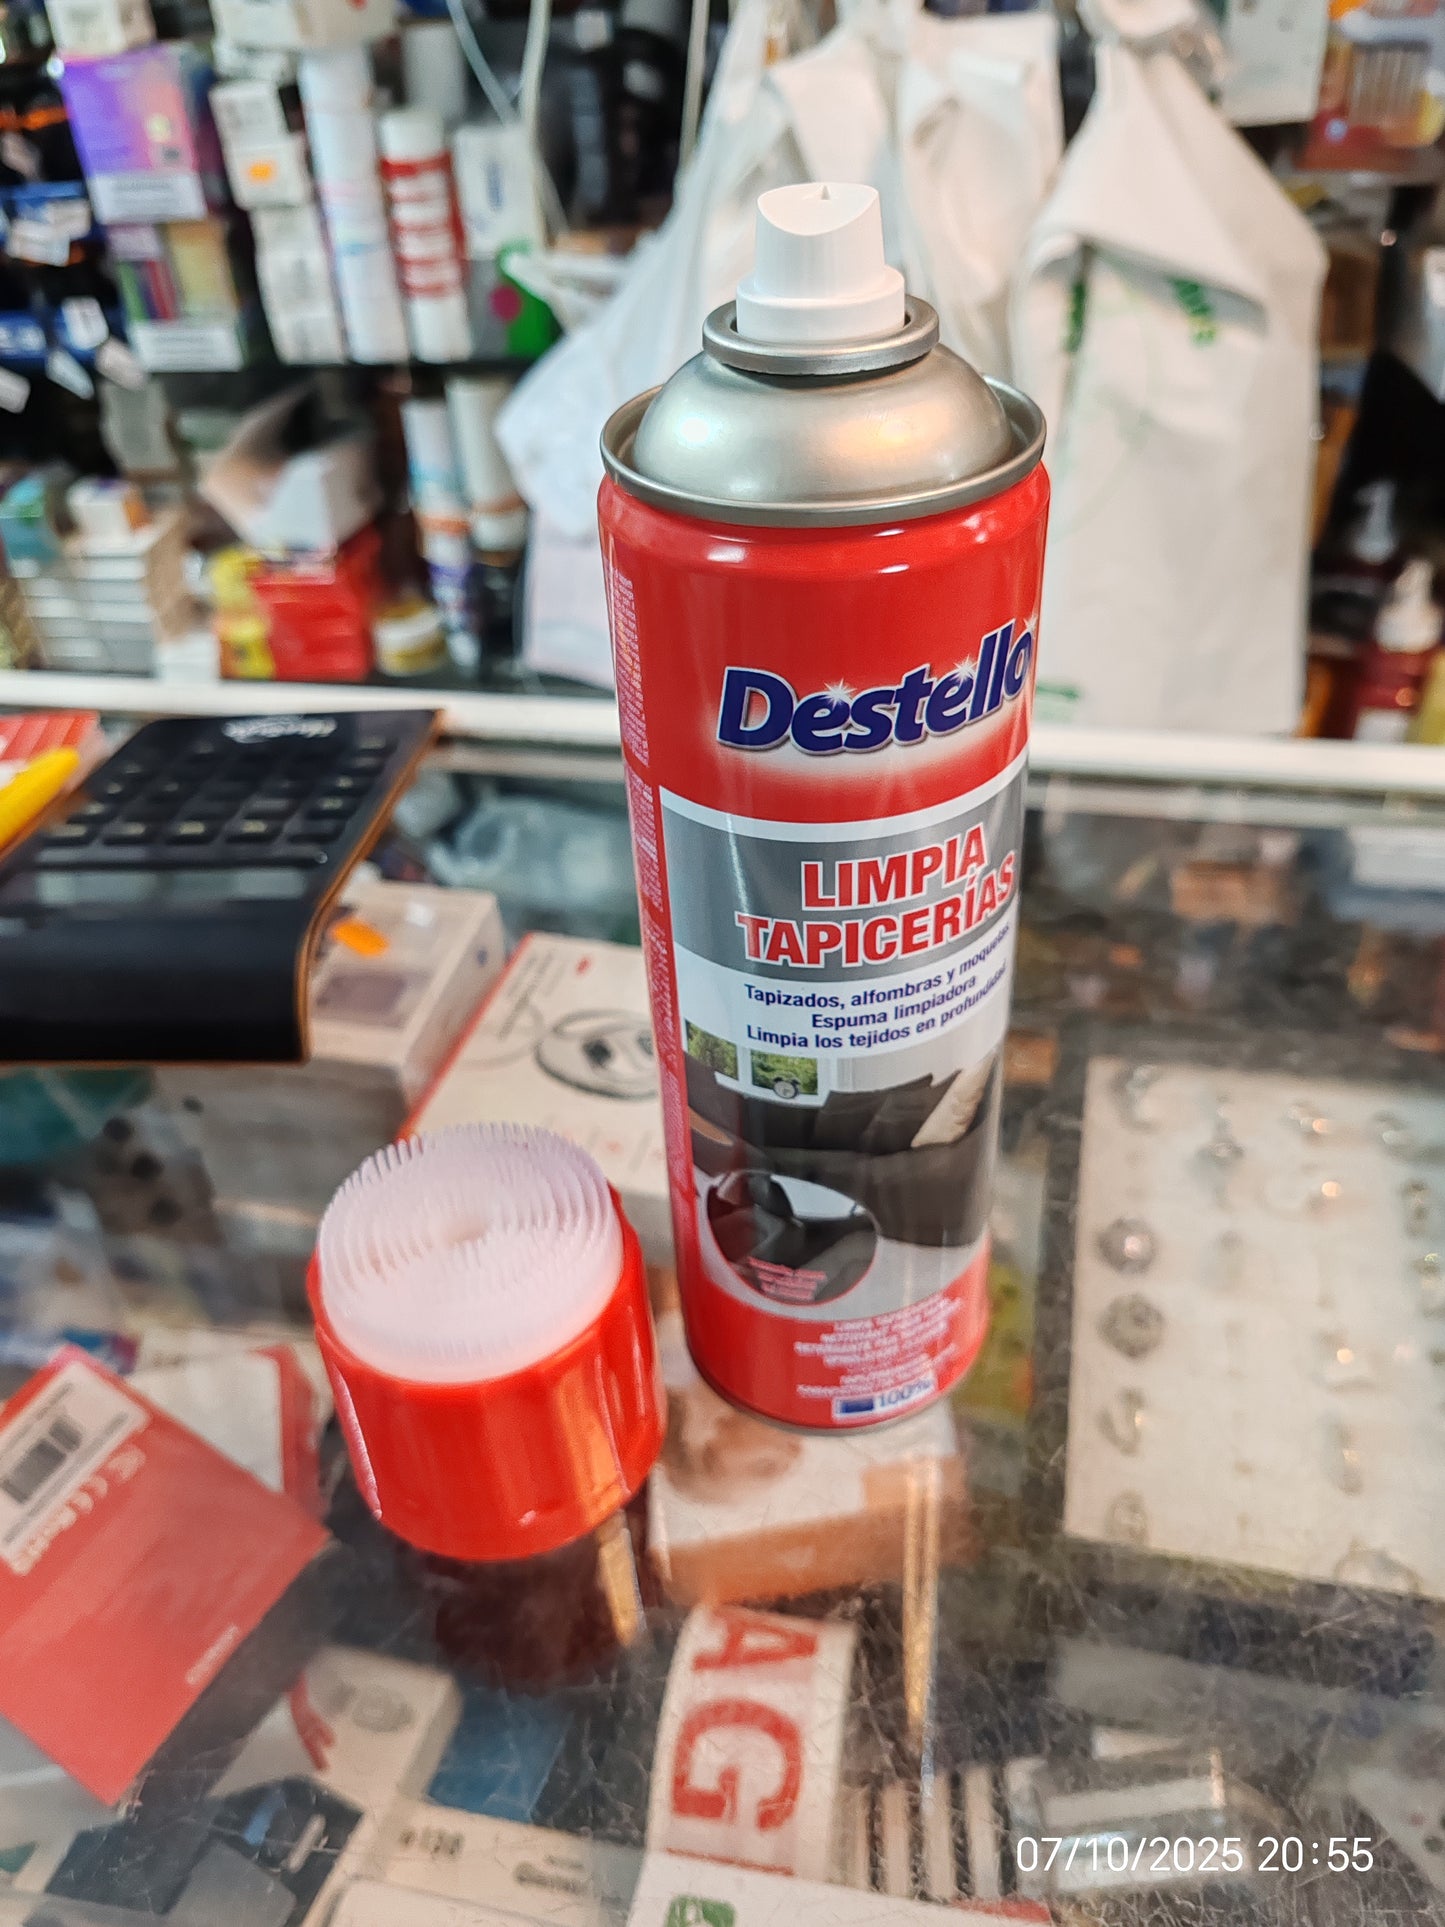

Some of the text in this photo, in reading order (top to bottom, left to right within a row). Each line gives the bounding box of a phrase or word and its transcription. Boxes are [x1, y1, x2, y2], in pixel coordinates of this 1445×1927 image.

[717, 619, 1034, 755] Destello
[802, 823, 987, 910] LIMPIA
[734, 850, 1016, 968] TAPICERÍAS
[744, 983, 845, 1010] Tapizados,
[851, 975, 942, 1007] alfombras
[947, 968, 955, 984] y
[811, 975, 977, 1031] Espuma limpiadora
[746, 1024, 809, 1048] Limpia
[815, 1034, 843, 1048] los
[849, 1026, 910, 1048] tejidos
[916, 1017, 936, 1034] en
